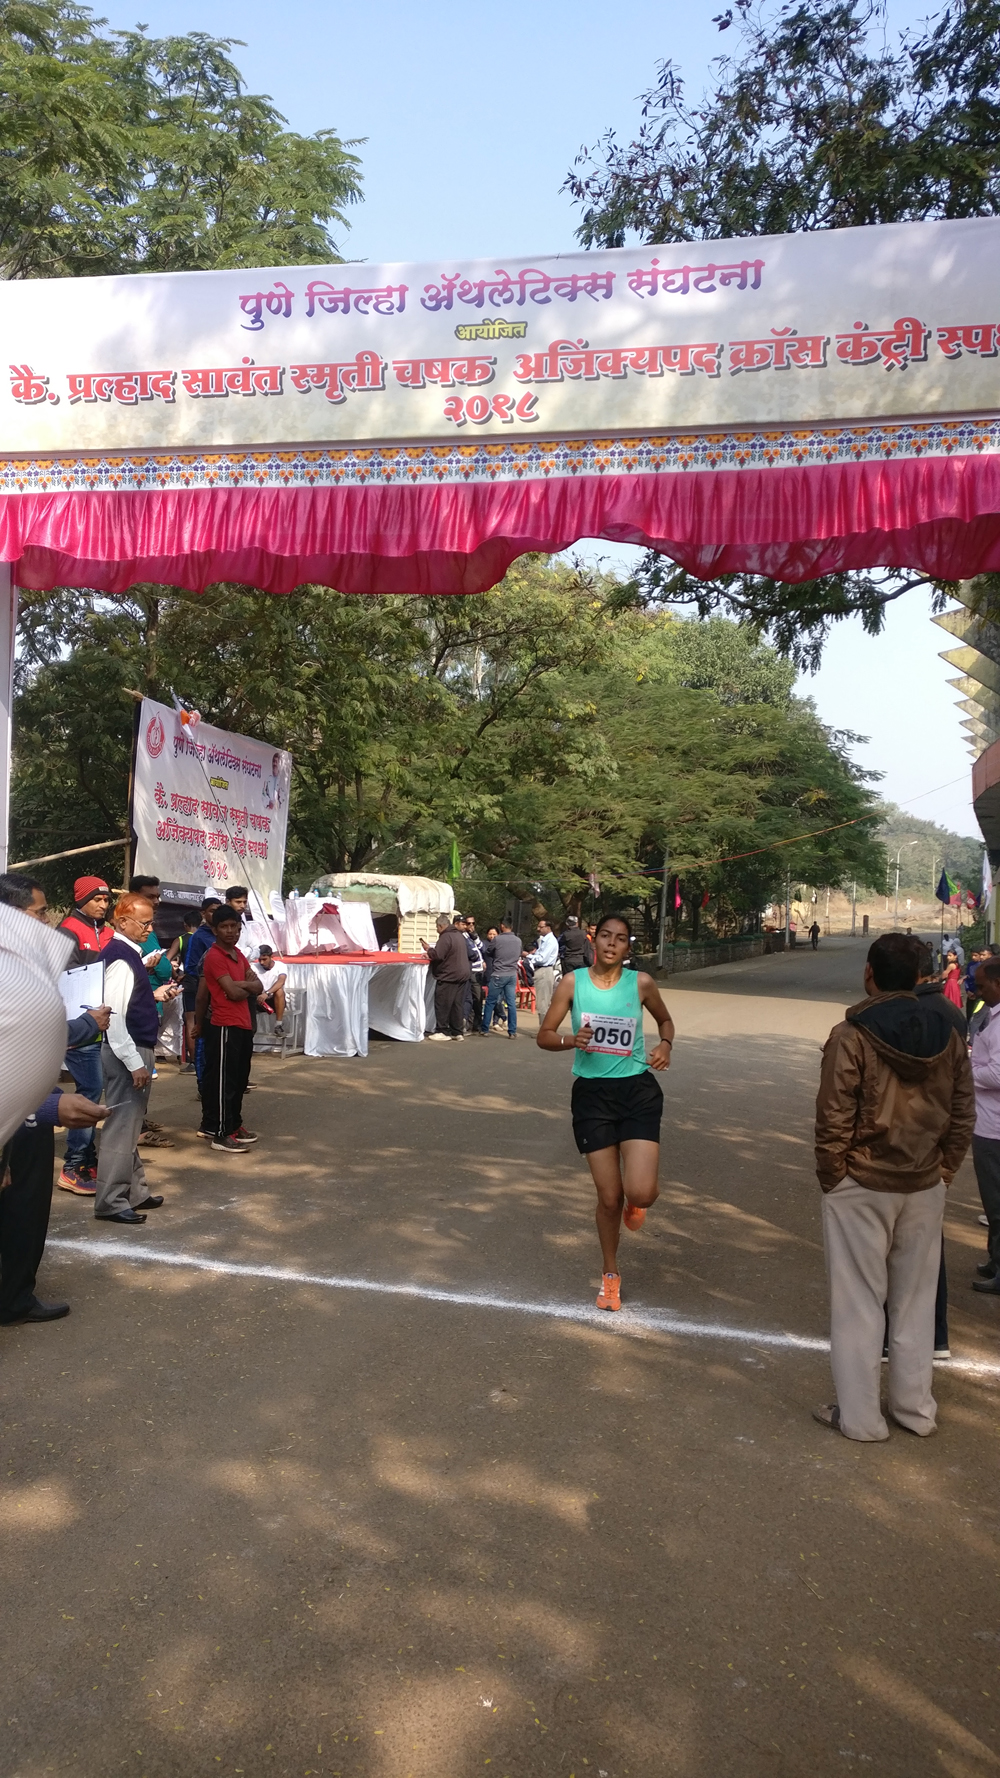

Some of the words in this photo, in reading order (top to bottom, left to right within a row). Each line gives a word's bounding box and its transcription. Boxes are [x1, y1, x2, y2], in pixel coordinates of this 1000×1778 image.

[238, 281, 296, 332] पुणे
[304, 280, 410, 318] जिल्हा
[626, 257, 766, 299] संघटना
[454, 318, 528, 341] आयोजित
[8, 364, 60, 406] कै.
[65, 369, 178, 405] प्रल्हाद
[180, 355, 286, 399] सावंत
[289, 350, 386, 405] स्मृती
[391, 355, 498, 389] चषक
[512, 338, 725, 384] अजिंक्यपद
[727, 326, 831, 376] क्रॉस
[835, 316, 932, 371] कंट्री
[442, 391, 540, 428] २०१८
[242, 756, 262, 779] संघटना
[170, 792, 199, 818] प्रल्हाद
[201, 798, 228, 823] सावंत
[229, 806, 249, 833] स्मृती
[249, 813, 272, 833] चषक
[156, 816, 207, 850] अजिंक्यपद
[207, 827, 230, 853] क्रॉस
[248, 838, 270, 860] स्पर्धा
